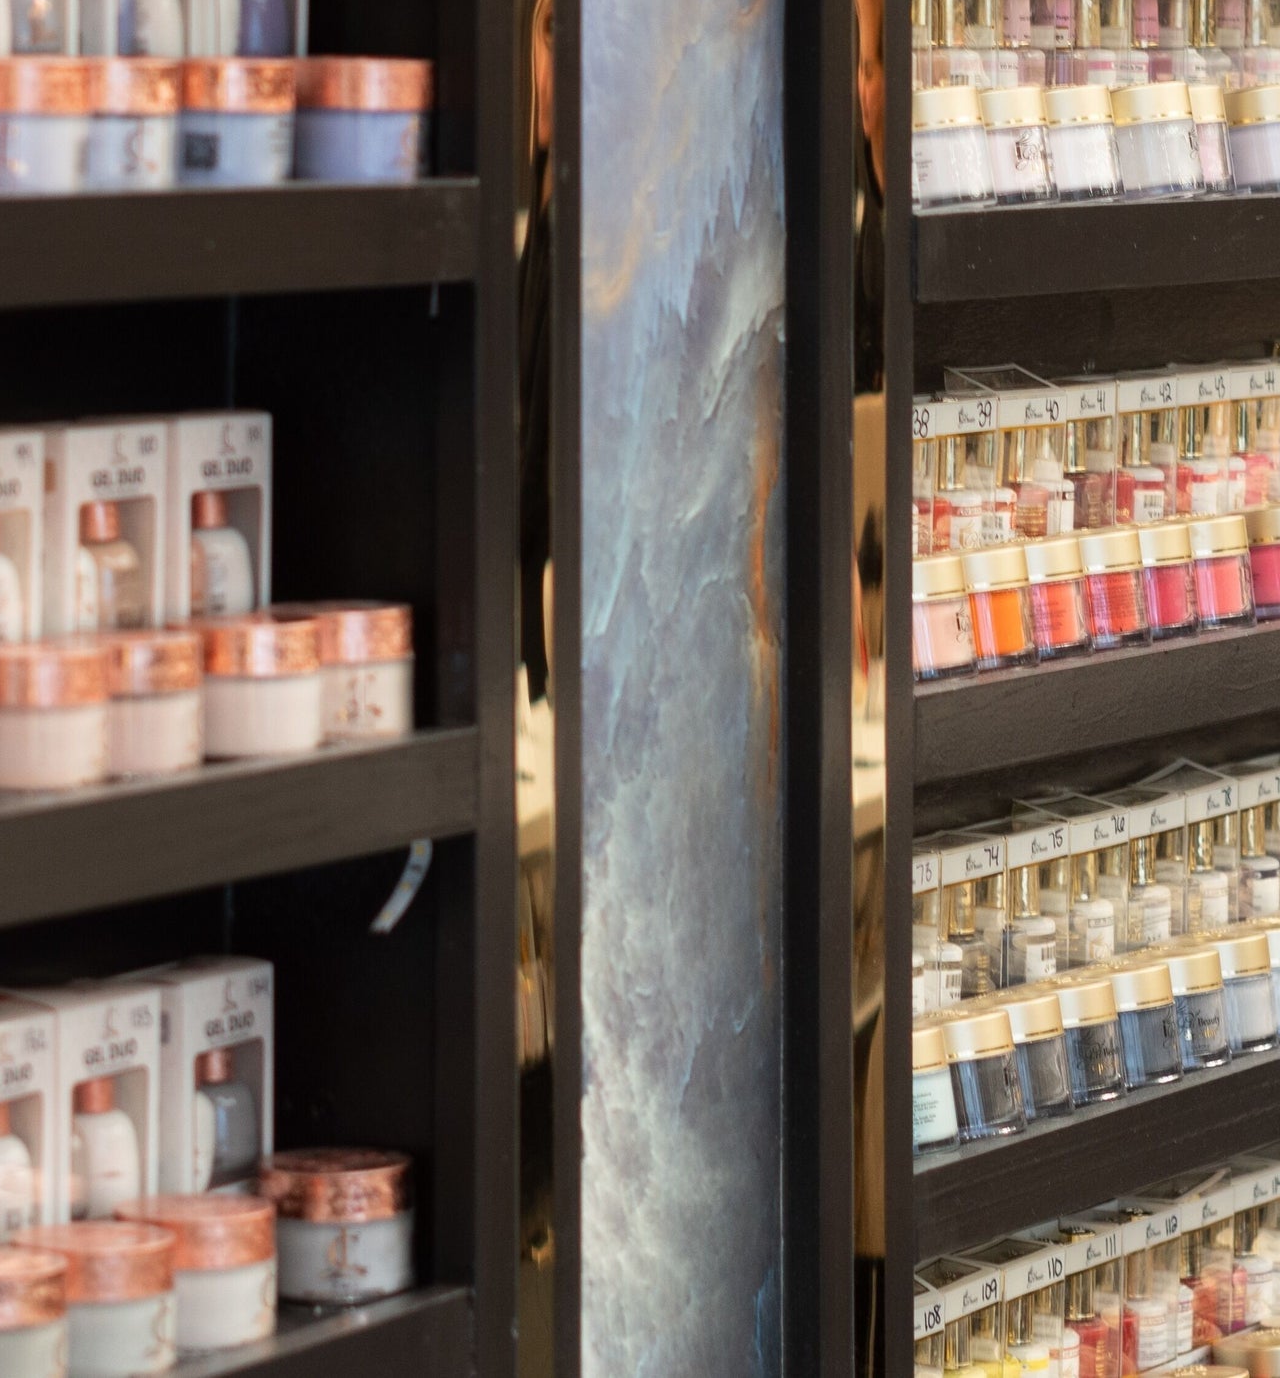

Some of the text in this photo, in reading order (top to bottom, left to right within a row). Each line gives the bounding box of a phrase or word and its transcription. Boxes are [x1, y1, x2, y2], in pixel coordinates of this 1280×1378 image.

[1215, 376, 1226, 399] 43
[1265, 369, 1276, 391] 44
[1097, 390, 1106, 413] 41
[1159, 382, 1172, 402] 42
[977, 399, 993, 428] 39
[1045, 398, 1060, 422] 40
[913, 408, 930, 439] 38
[1222, 787, 1232, 807] 78
[1049, 827, 1063, 849] 75
[984, 845, 1000, 867] 74
[1166, 1216, 1178, 1235] 112
[1105, 1234, 1116, 1257] 111
[1047, 1257, 1063, 1278] 110
[981, 1278, 998, 1302] 109
[924, 1303, 942, 1332] 108
